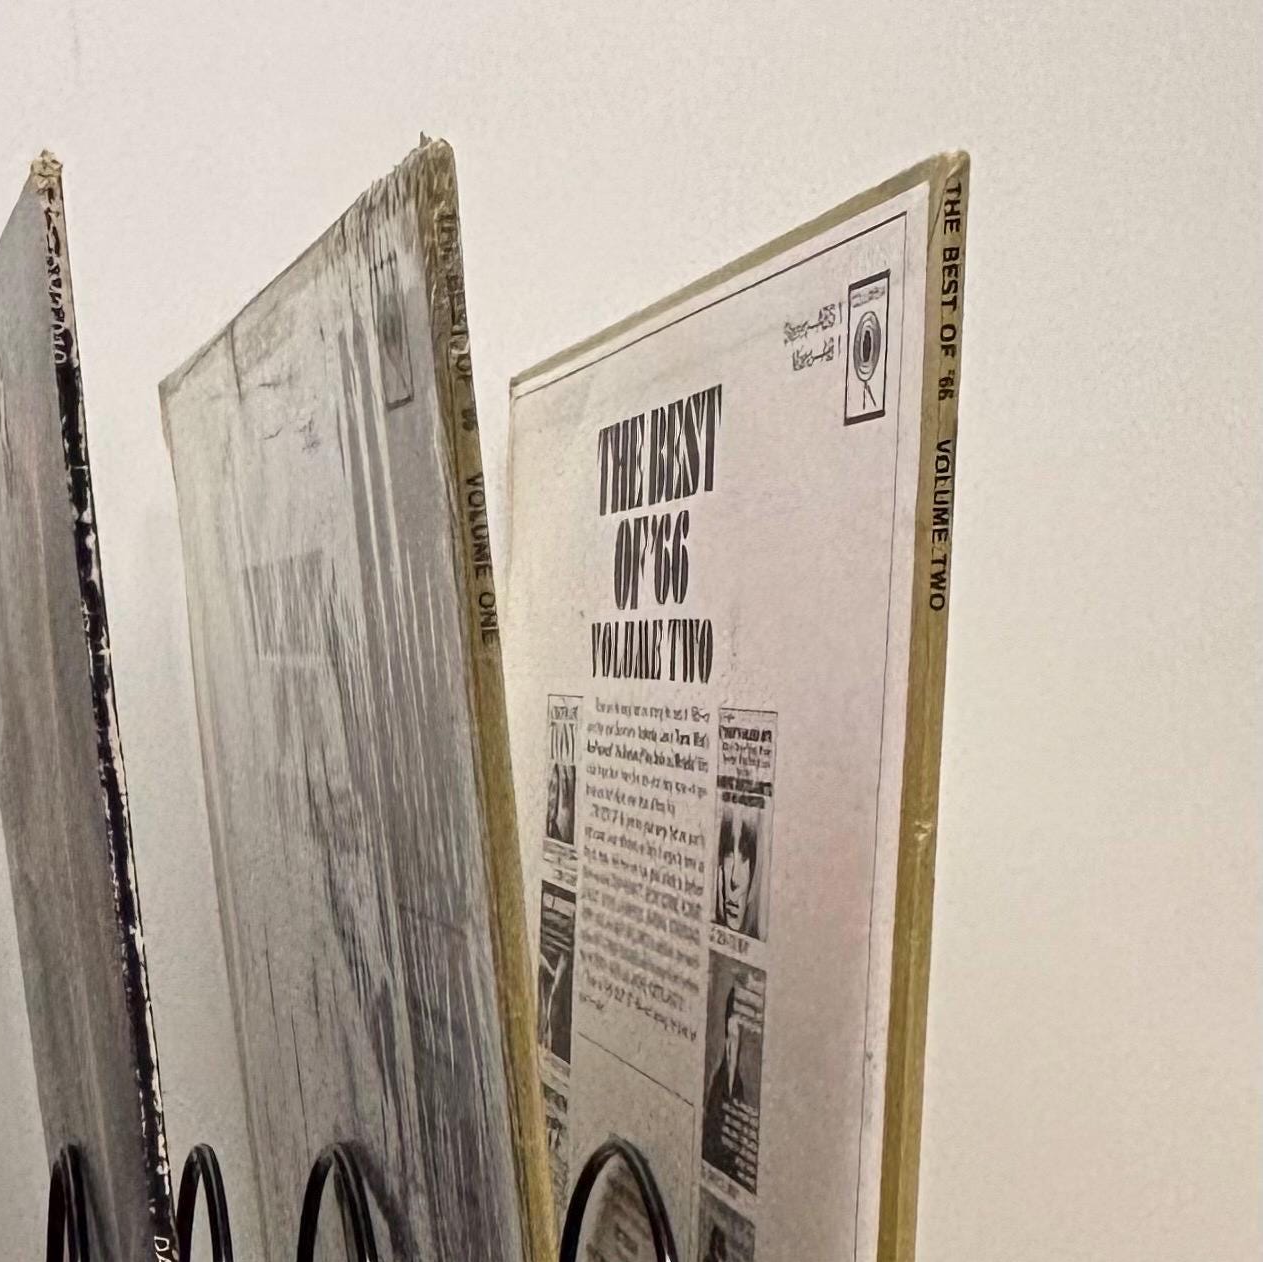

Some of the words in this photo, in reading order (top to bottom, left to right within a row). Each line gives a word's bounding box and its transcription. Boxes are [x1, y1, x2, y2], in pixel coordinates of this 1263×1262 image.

[944, 181, 962, 235] THE
[941, 246, 961, 312] BEST
[940, 323, 957, 359] OF
[597, 412, 645, 516] THE
[648, 384, 723, 506] BEST
[932, 439, 952, 544] VOLUME
[465, 472, 493, 580] VOLUME
[929, 553, 948, 612] TWO
[478, 591, 501, 646] ONE
[591, 619, 664, 679] VOLUME
[668, 618, 713, 684] TWO
